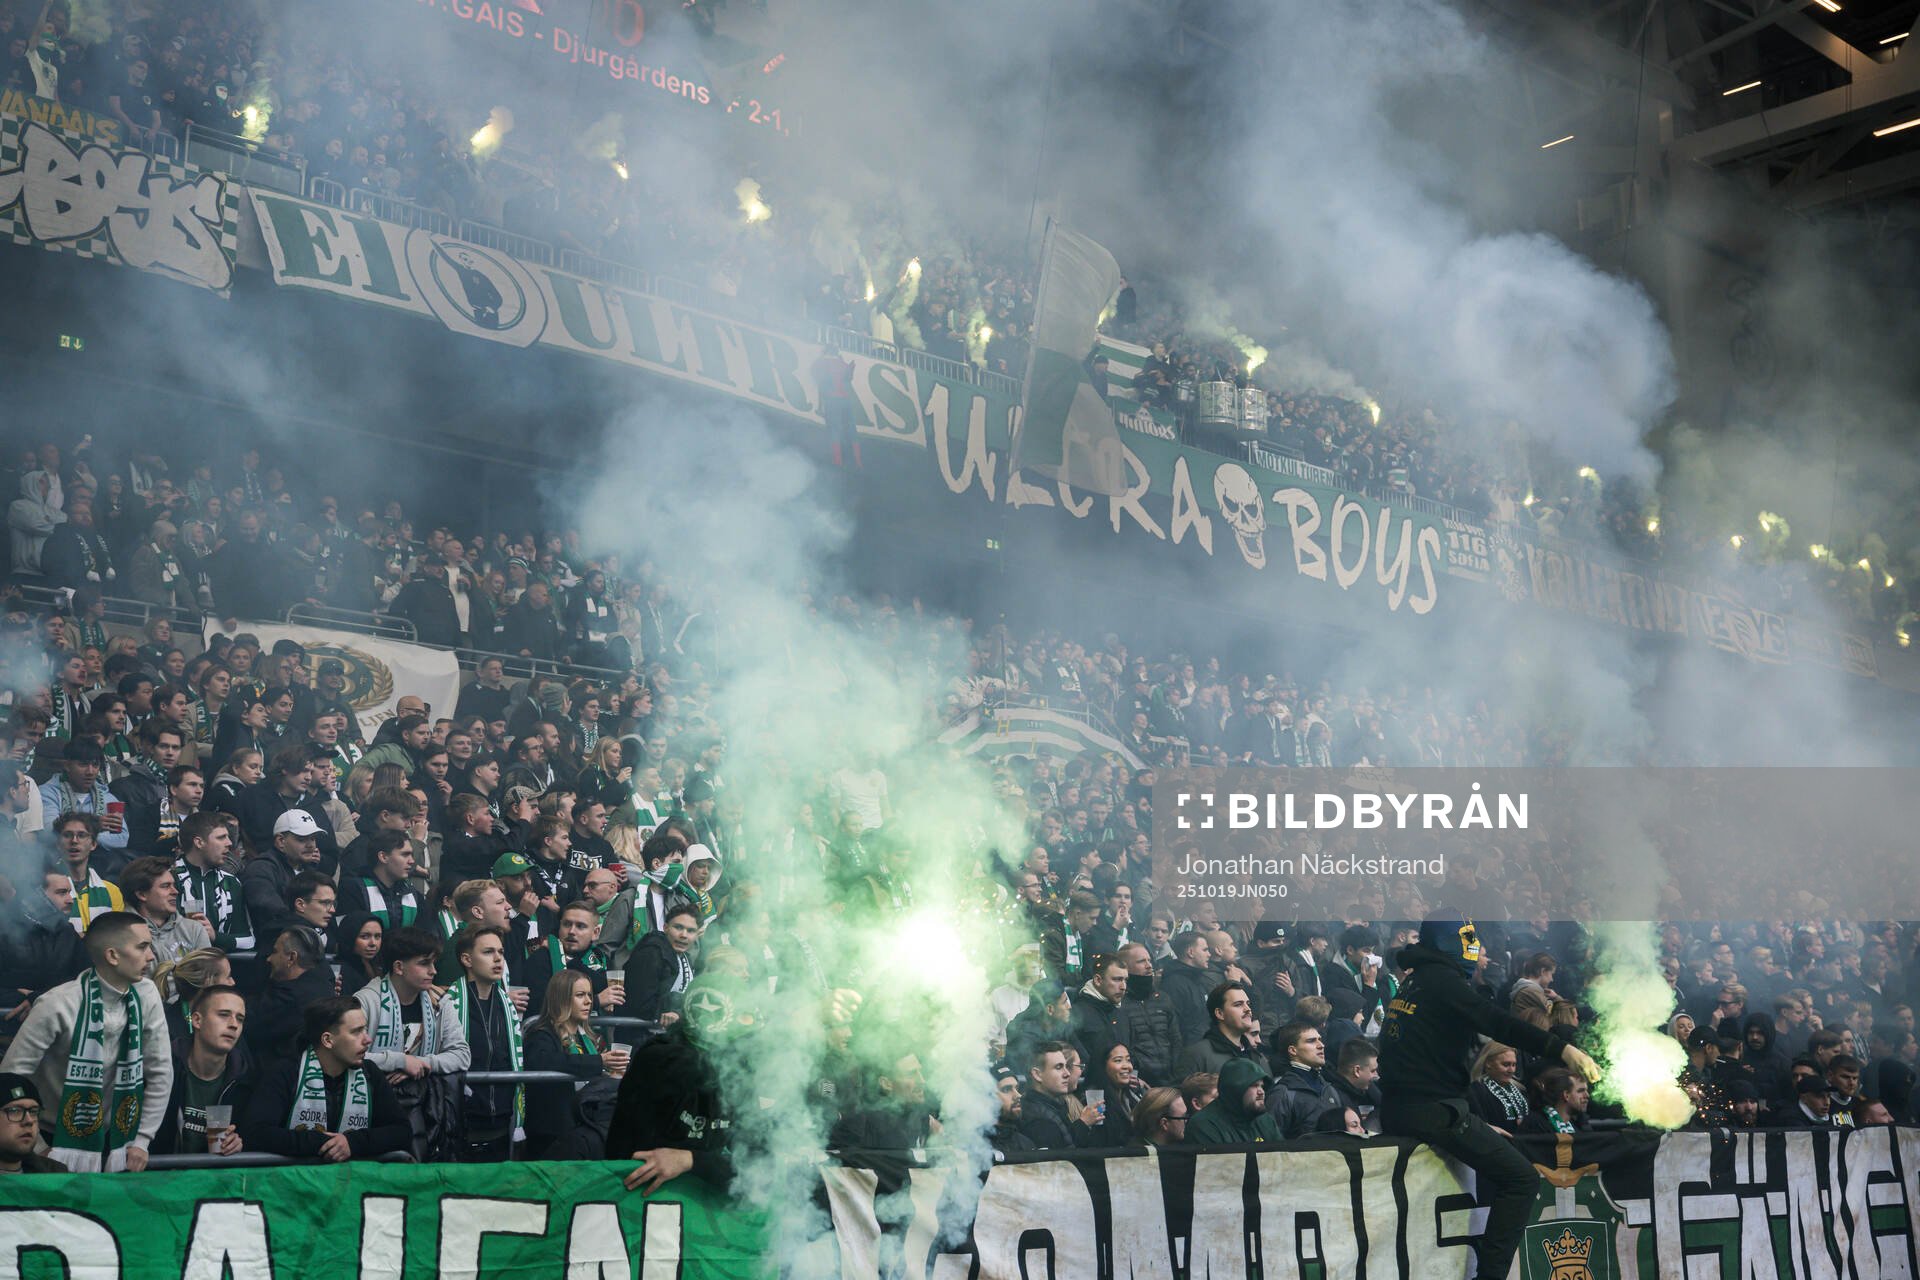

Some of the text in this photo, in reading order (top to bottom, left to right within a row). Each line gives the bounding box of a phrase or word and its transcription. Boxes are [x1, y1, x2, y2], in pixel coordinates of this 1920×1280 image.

[553, 27, 711, 105] Djurgårdens
[1272, 487, 1441, 615] BOYS
[1448, 531, 1488, 556] 116
[1448, 550, 1491, 571] SOFIA
[70, 1065, 88, 1079] EST.
